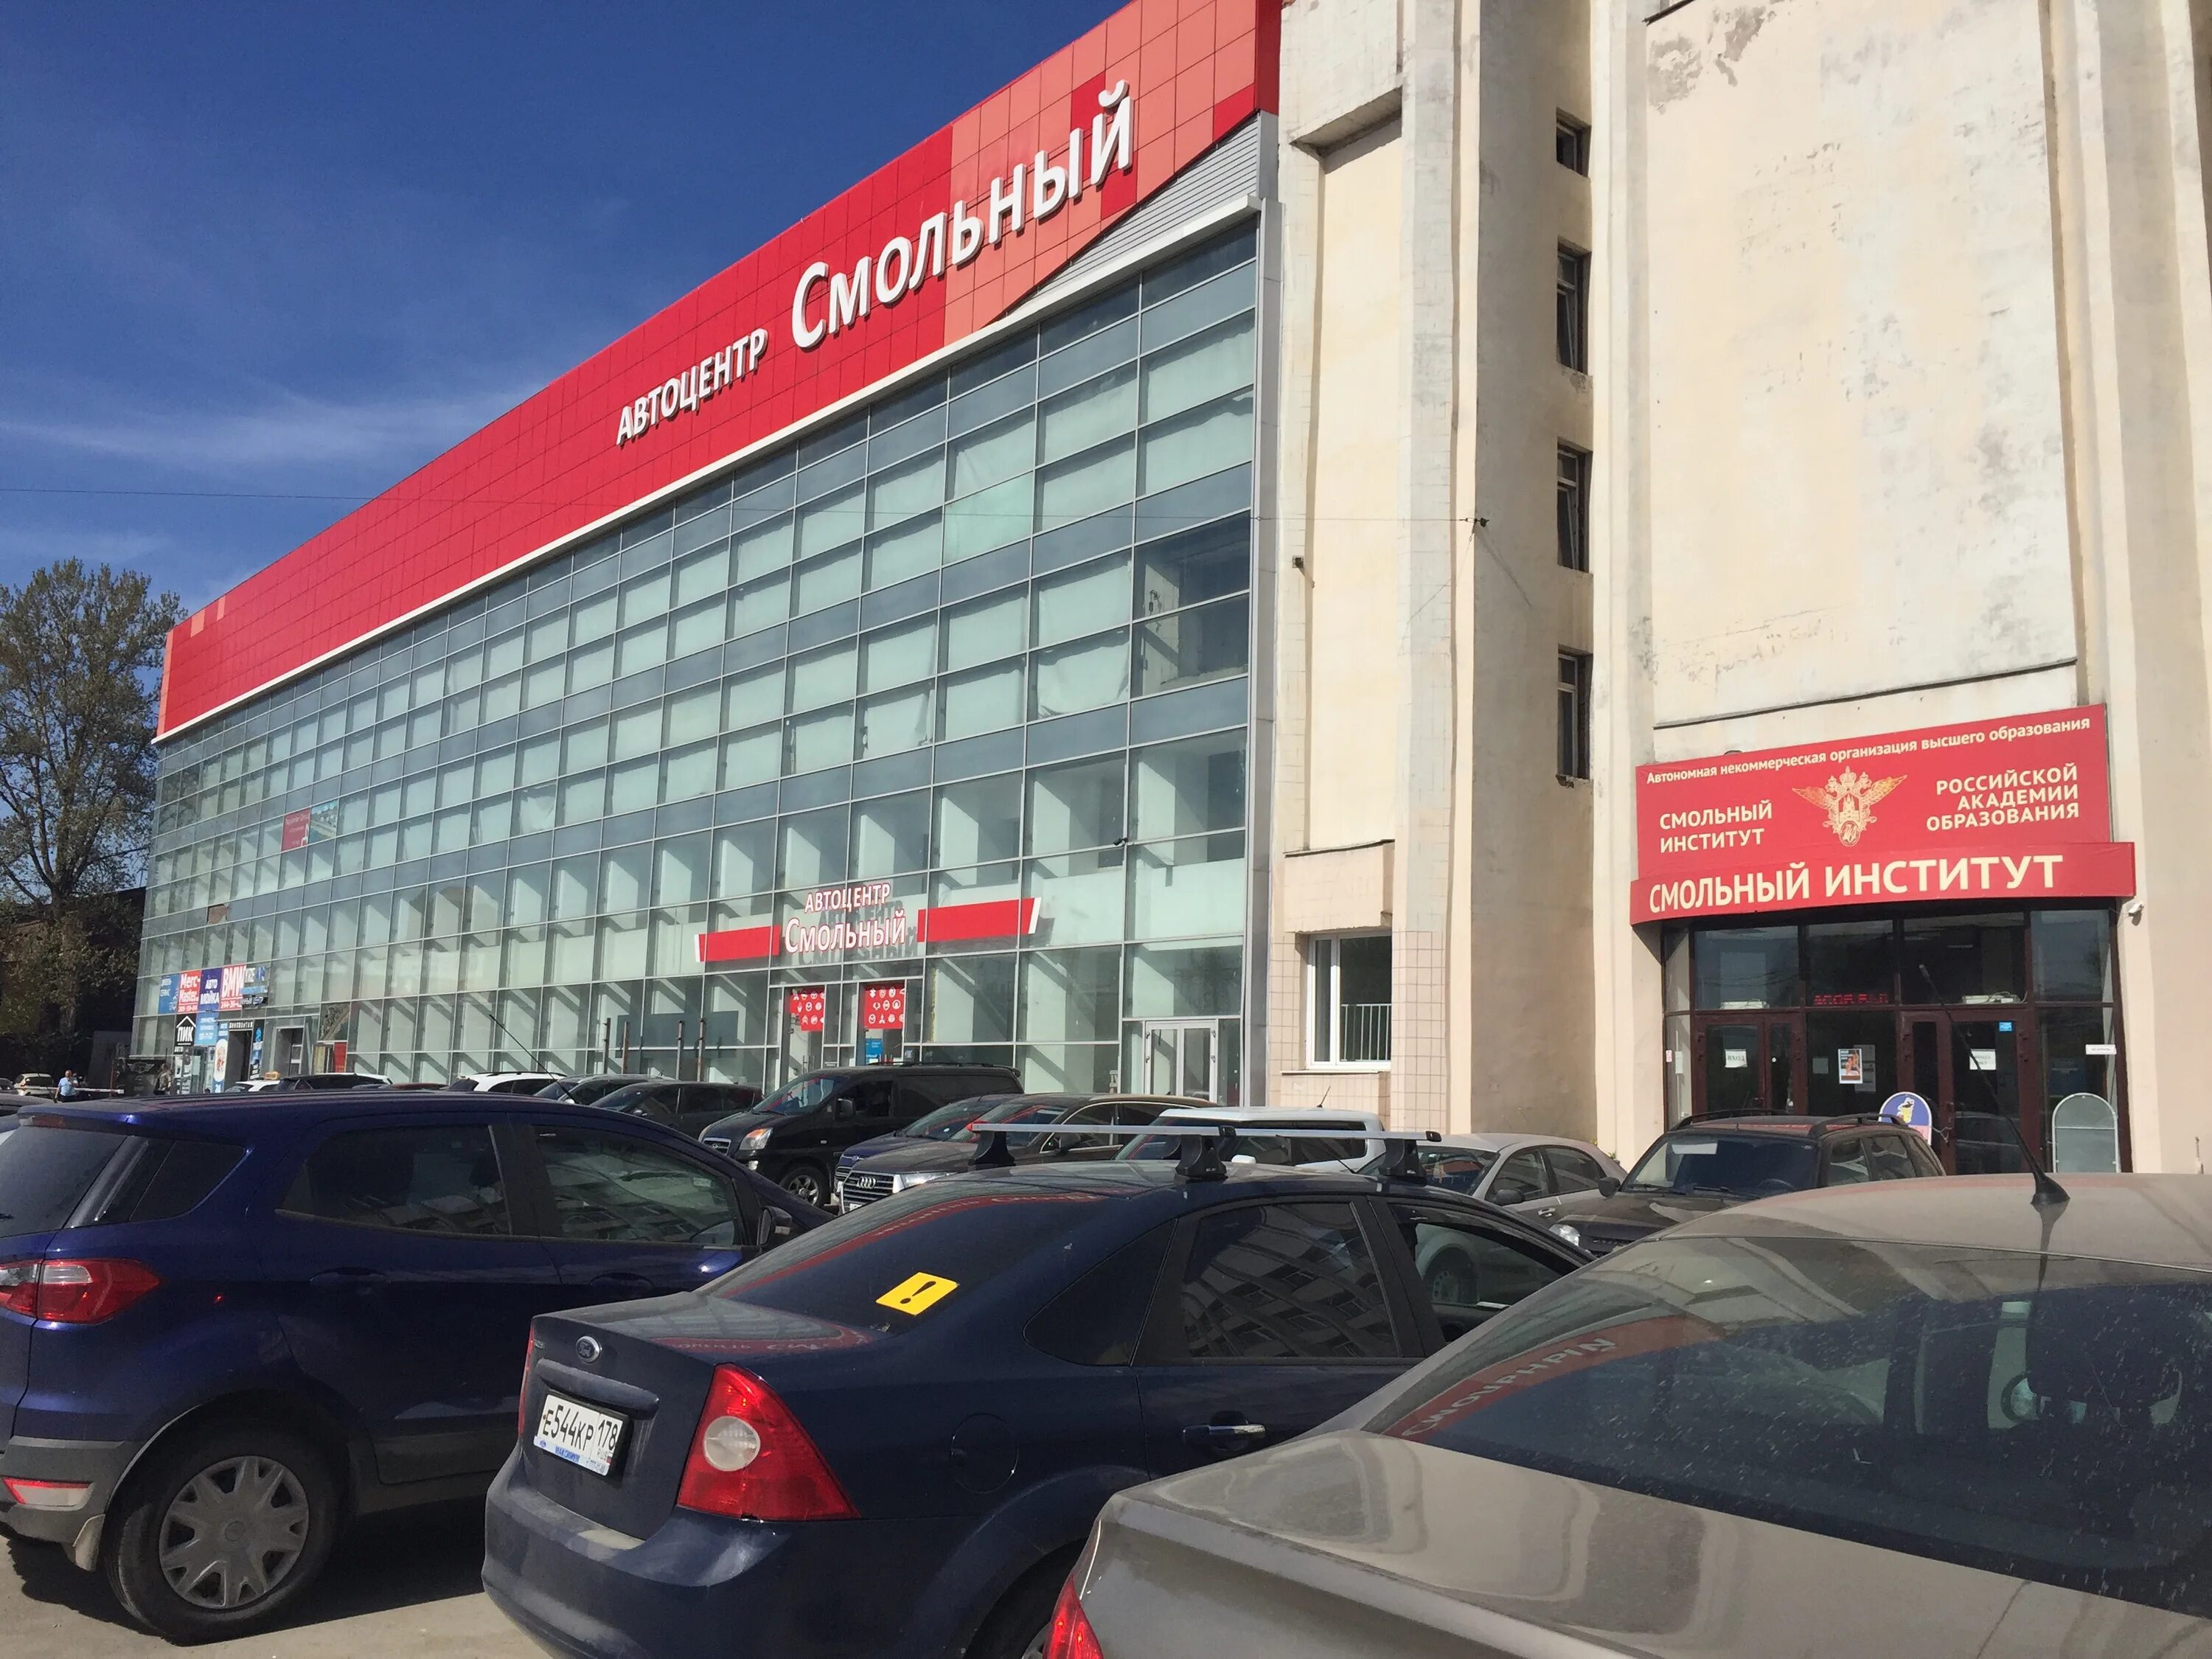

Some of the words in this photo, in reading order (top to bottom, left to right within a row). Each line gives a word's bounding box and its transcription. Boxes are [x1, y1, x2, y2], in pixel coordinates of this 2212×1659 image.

[616, 328, 768, 445] АВТОЦЕНТР
[1646, 766, 1717, 784] Автономная
[1720, 752, 1826, 775] некоммерческая
[1829, 739, 1917, 763] организация
[1921, 731, 1985, 750] высшего
[1989, 717, 2090, 742] образования
[1936, 762, 2078, 795] РОССИЙСКОЙ
[1958, 784, 2079, 811] АКАДЕМИИ
[1660, 799, 1773, 831] СМОЛЬНЫЙ
[1926, 801, 2079, 831] ОБРАЗОВАНИЯ
[1660, 827, 1765, 853] ИНСТИТУТ
[804, 883, 891, 914] АВТОЦЕНТР
[1649, 861, 1810, 914] СМОЛЬНЫЙ
[1825, 855, 2063, 897] ИНСТИТУТ
[177, 1026, 194, 1042] ПИК
